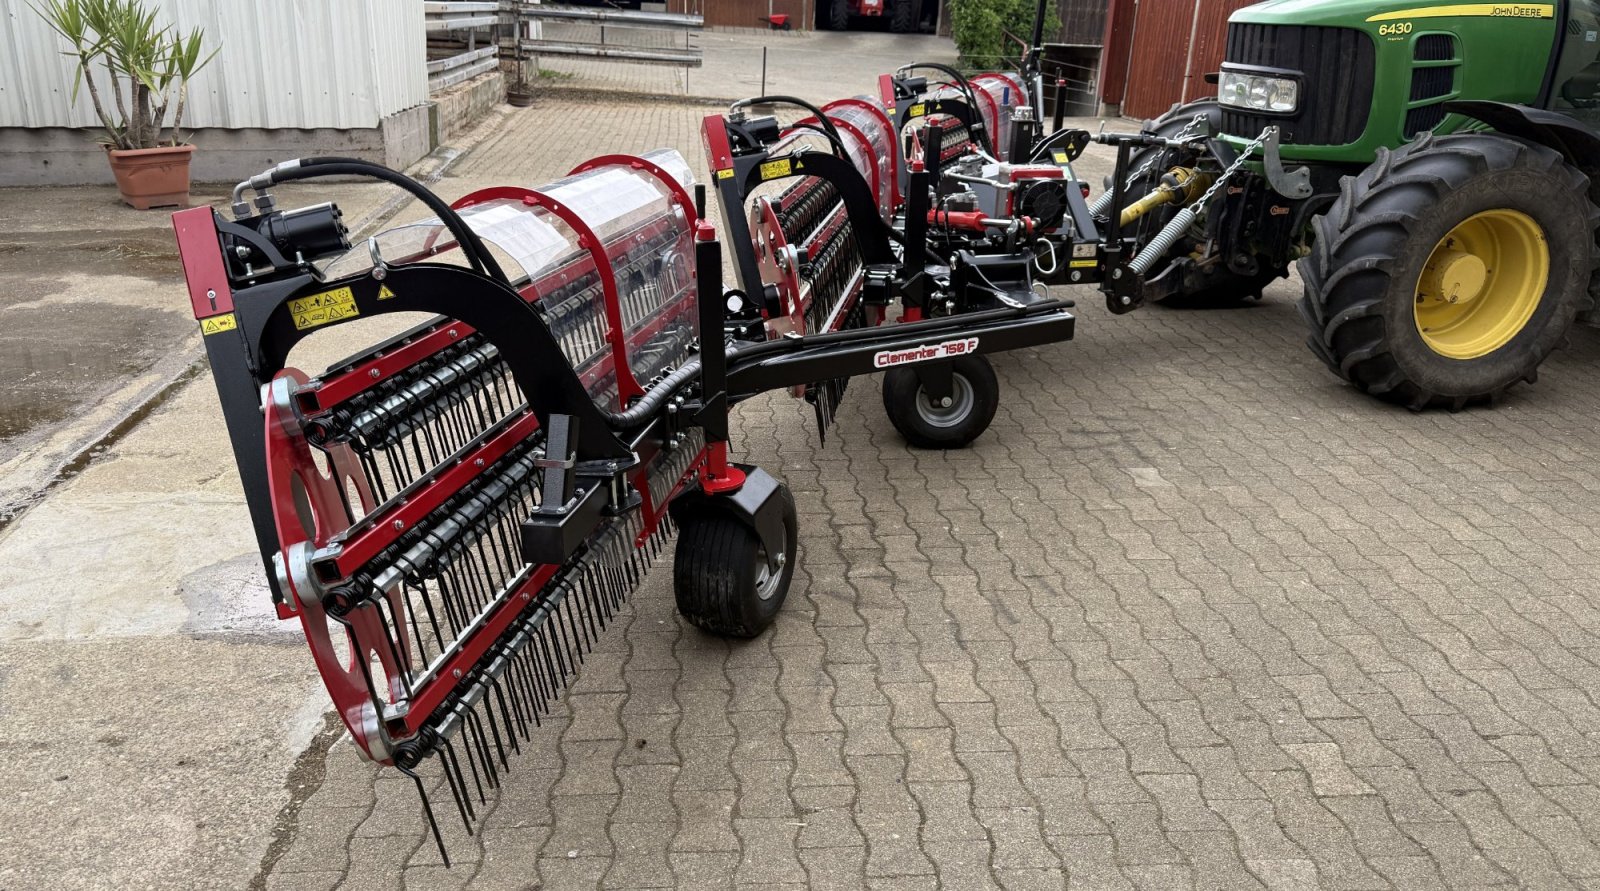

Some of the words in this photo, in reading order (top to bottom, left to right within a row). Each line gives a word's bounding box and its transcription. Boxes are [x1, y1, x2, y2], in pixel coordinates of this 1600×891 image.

[1379, 22, 1412, 36] 6430
[877, 347, 939, 366] Clementer
[942, 342, 966, 355] 750
[967, 340, 977, 352] F
